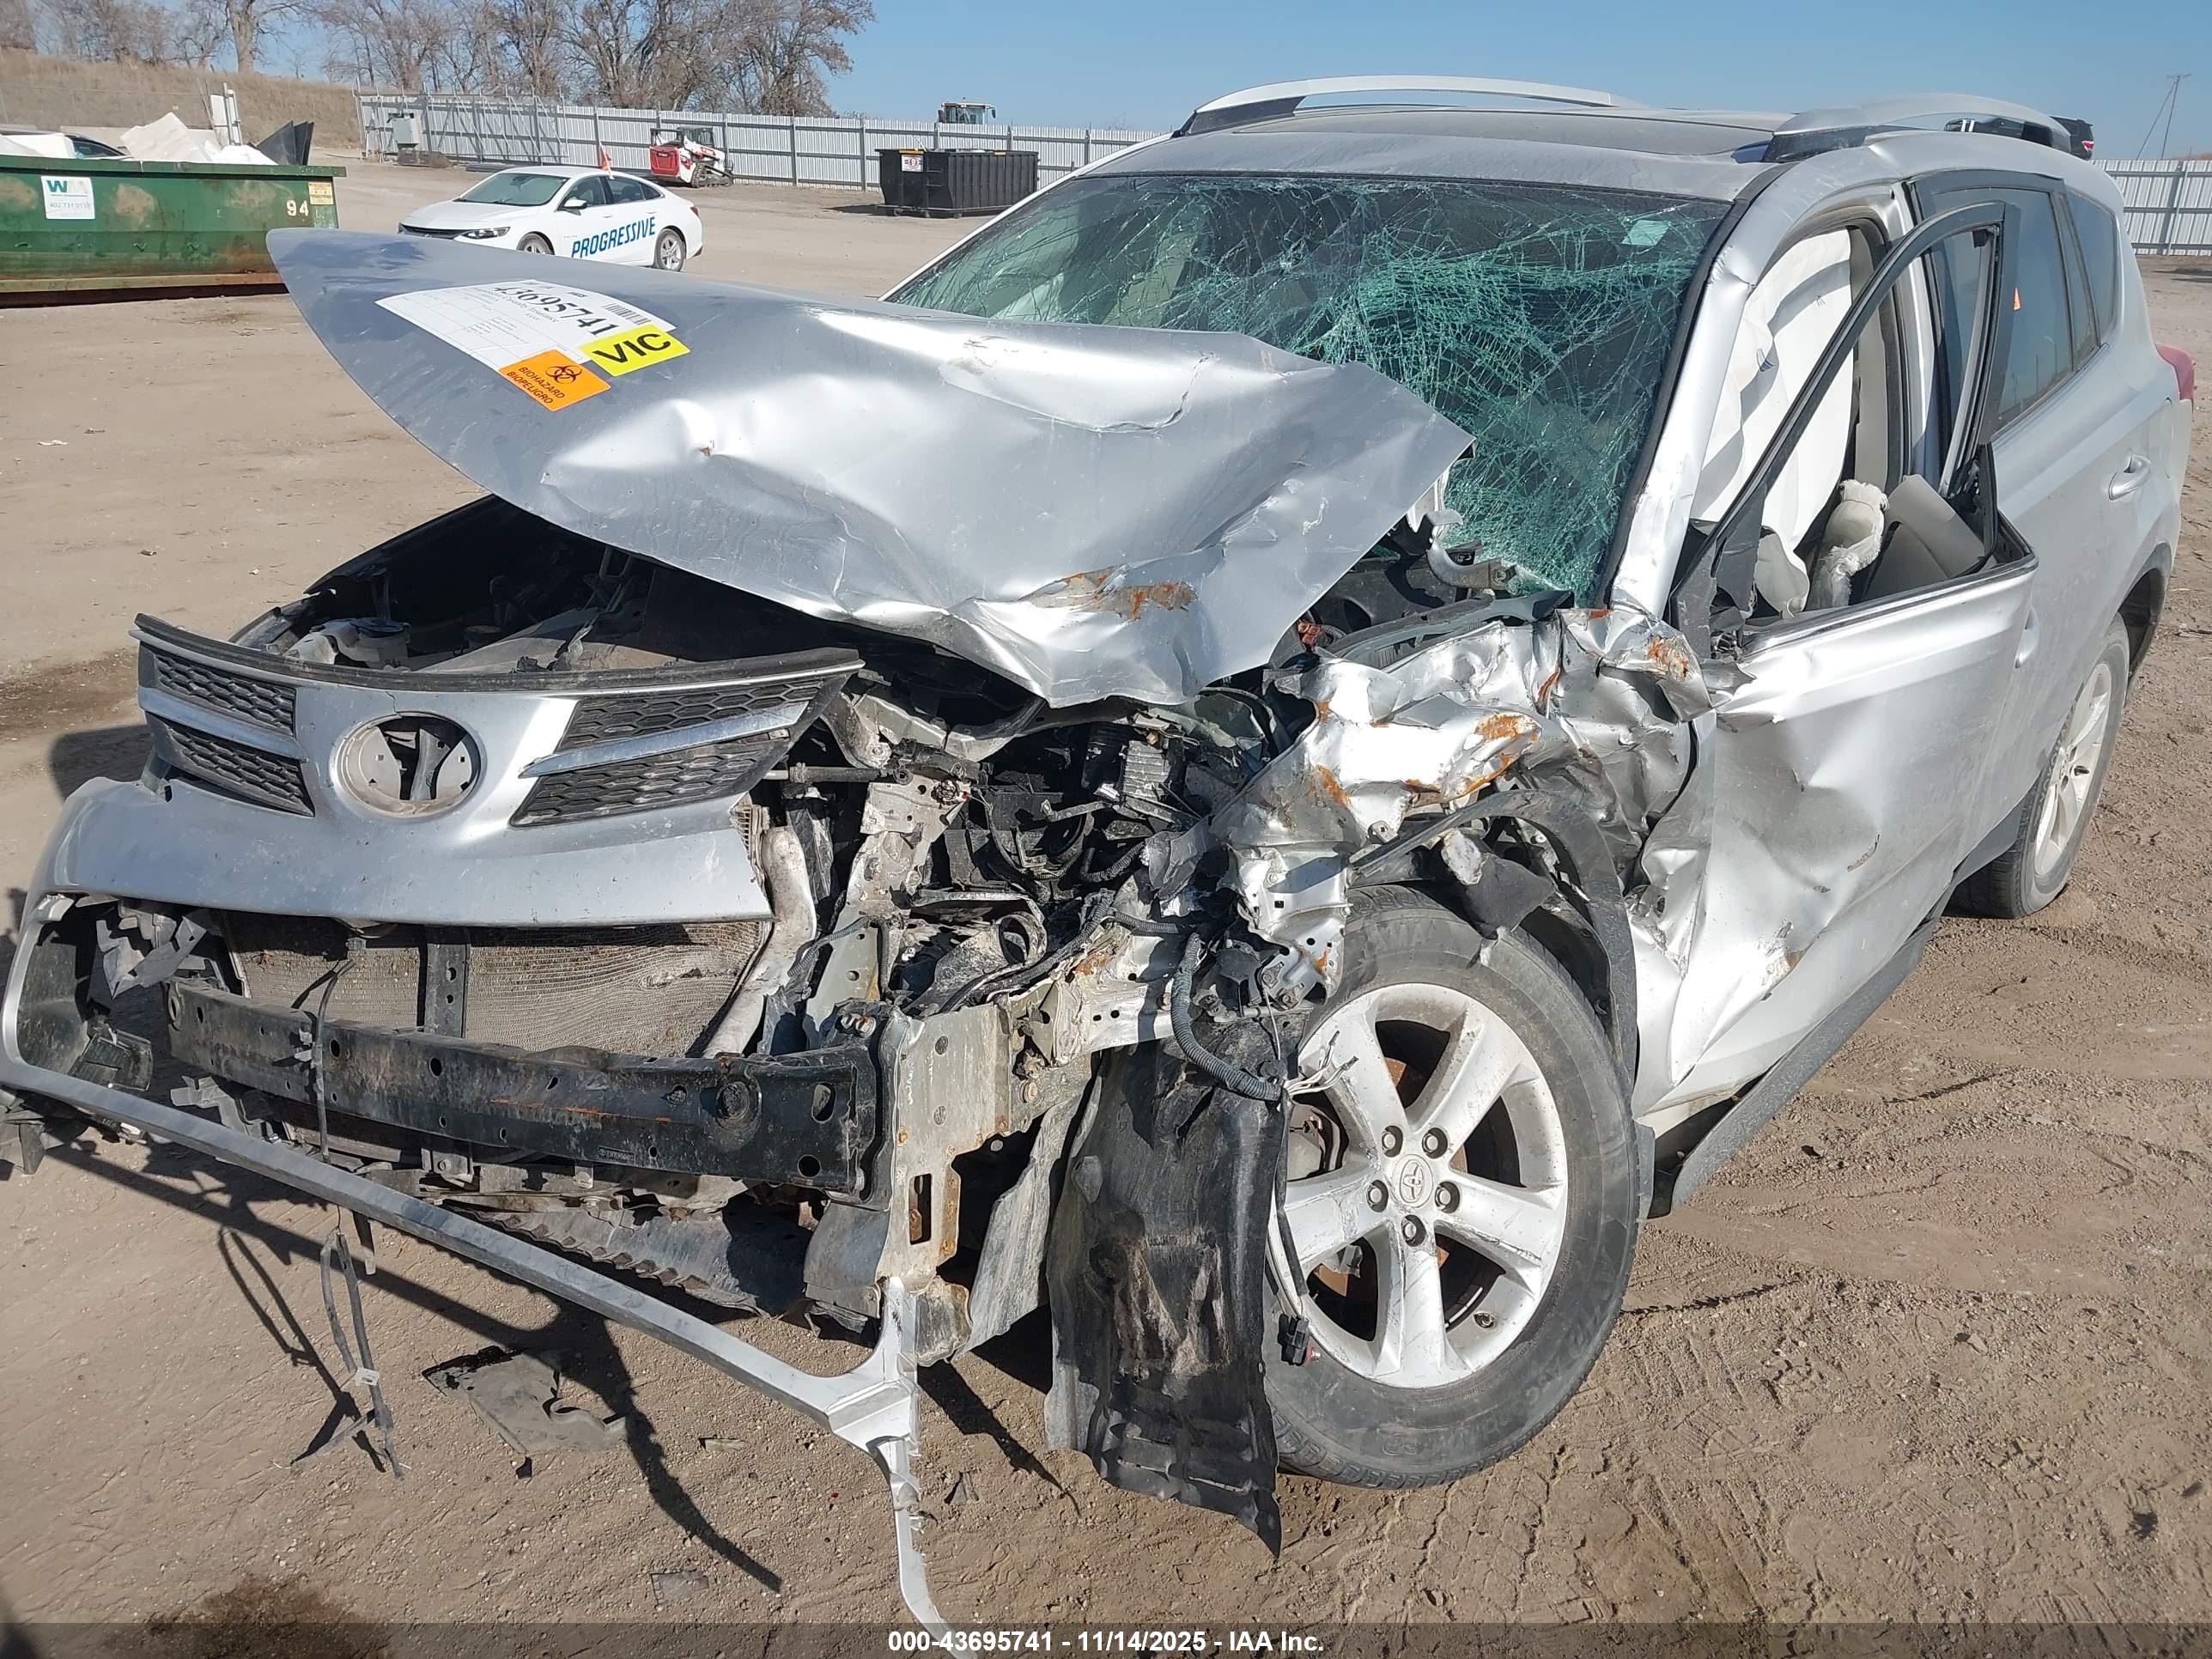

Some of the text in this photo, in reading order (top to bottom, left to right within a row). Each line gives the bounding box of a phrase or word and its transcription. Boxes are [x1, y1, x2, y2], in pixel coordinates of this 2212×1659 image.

[286, 199, 309, 216] 94
[571, 216, 655, 258] PROGRESSIVE
[494, 287, 619, 337] 43695741
[592, 333, 672, 364] VIC
[506, 371, 554, 404] BIOPELIGRO
[518, 367, 565, 399] BIOHAZARD
